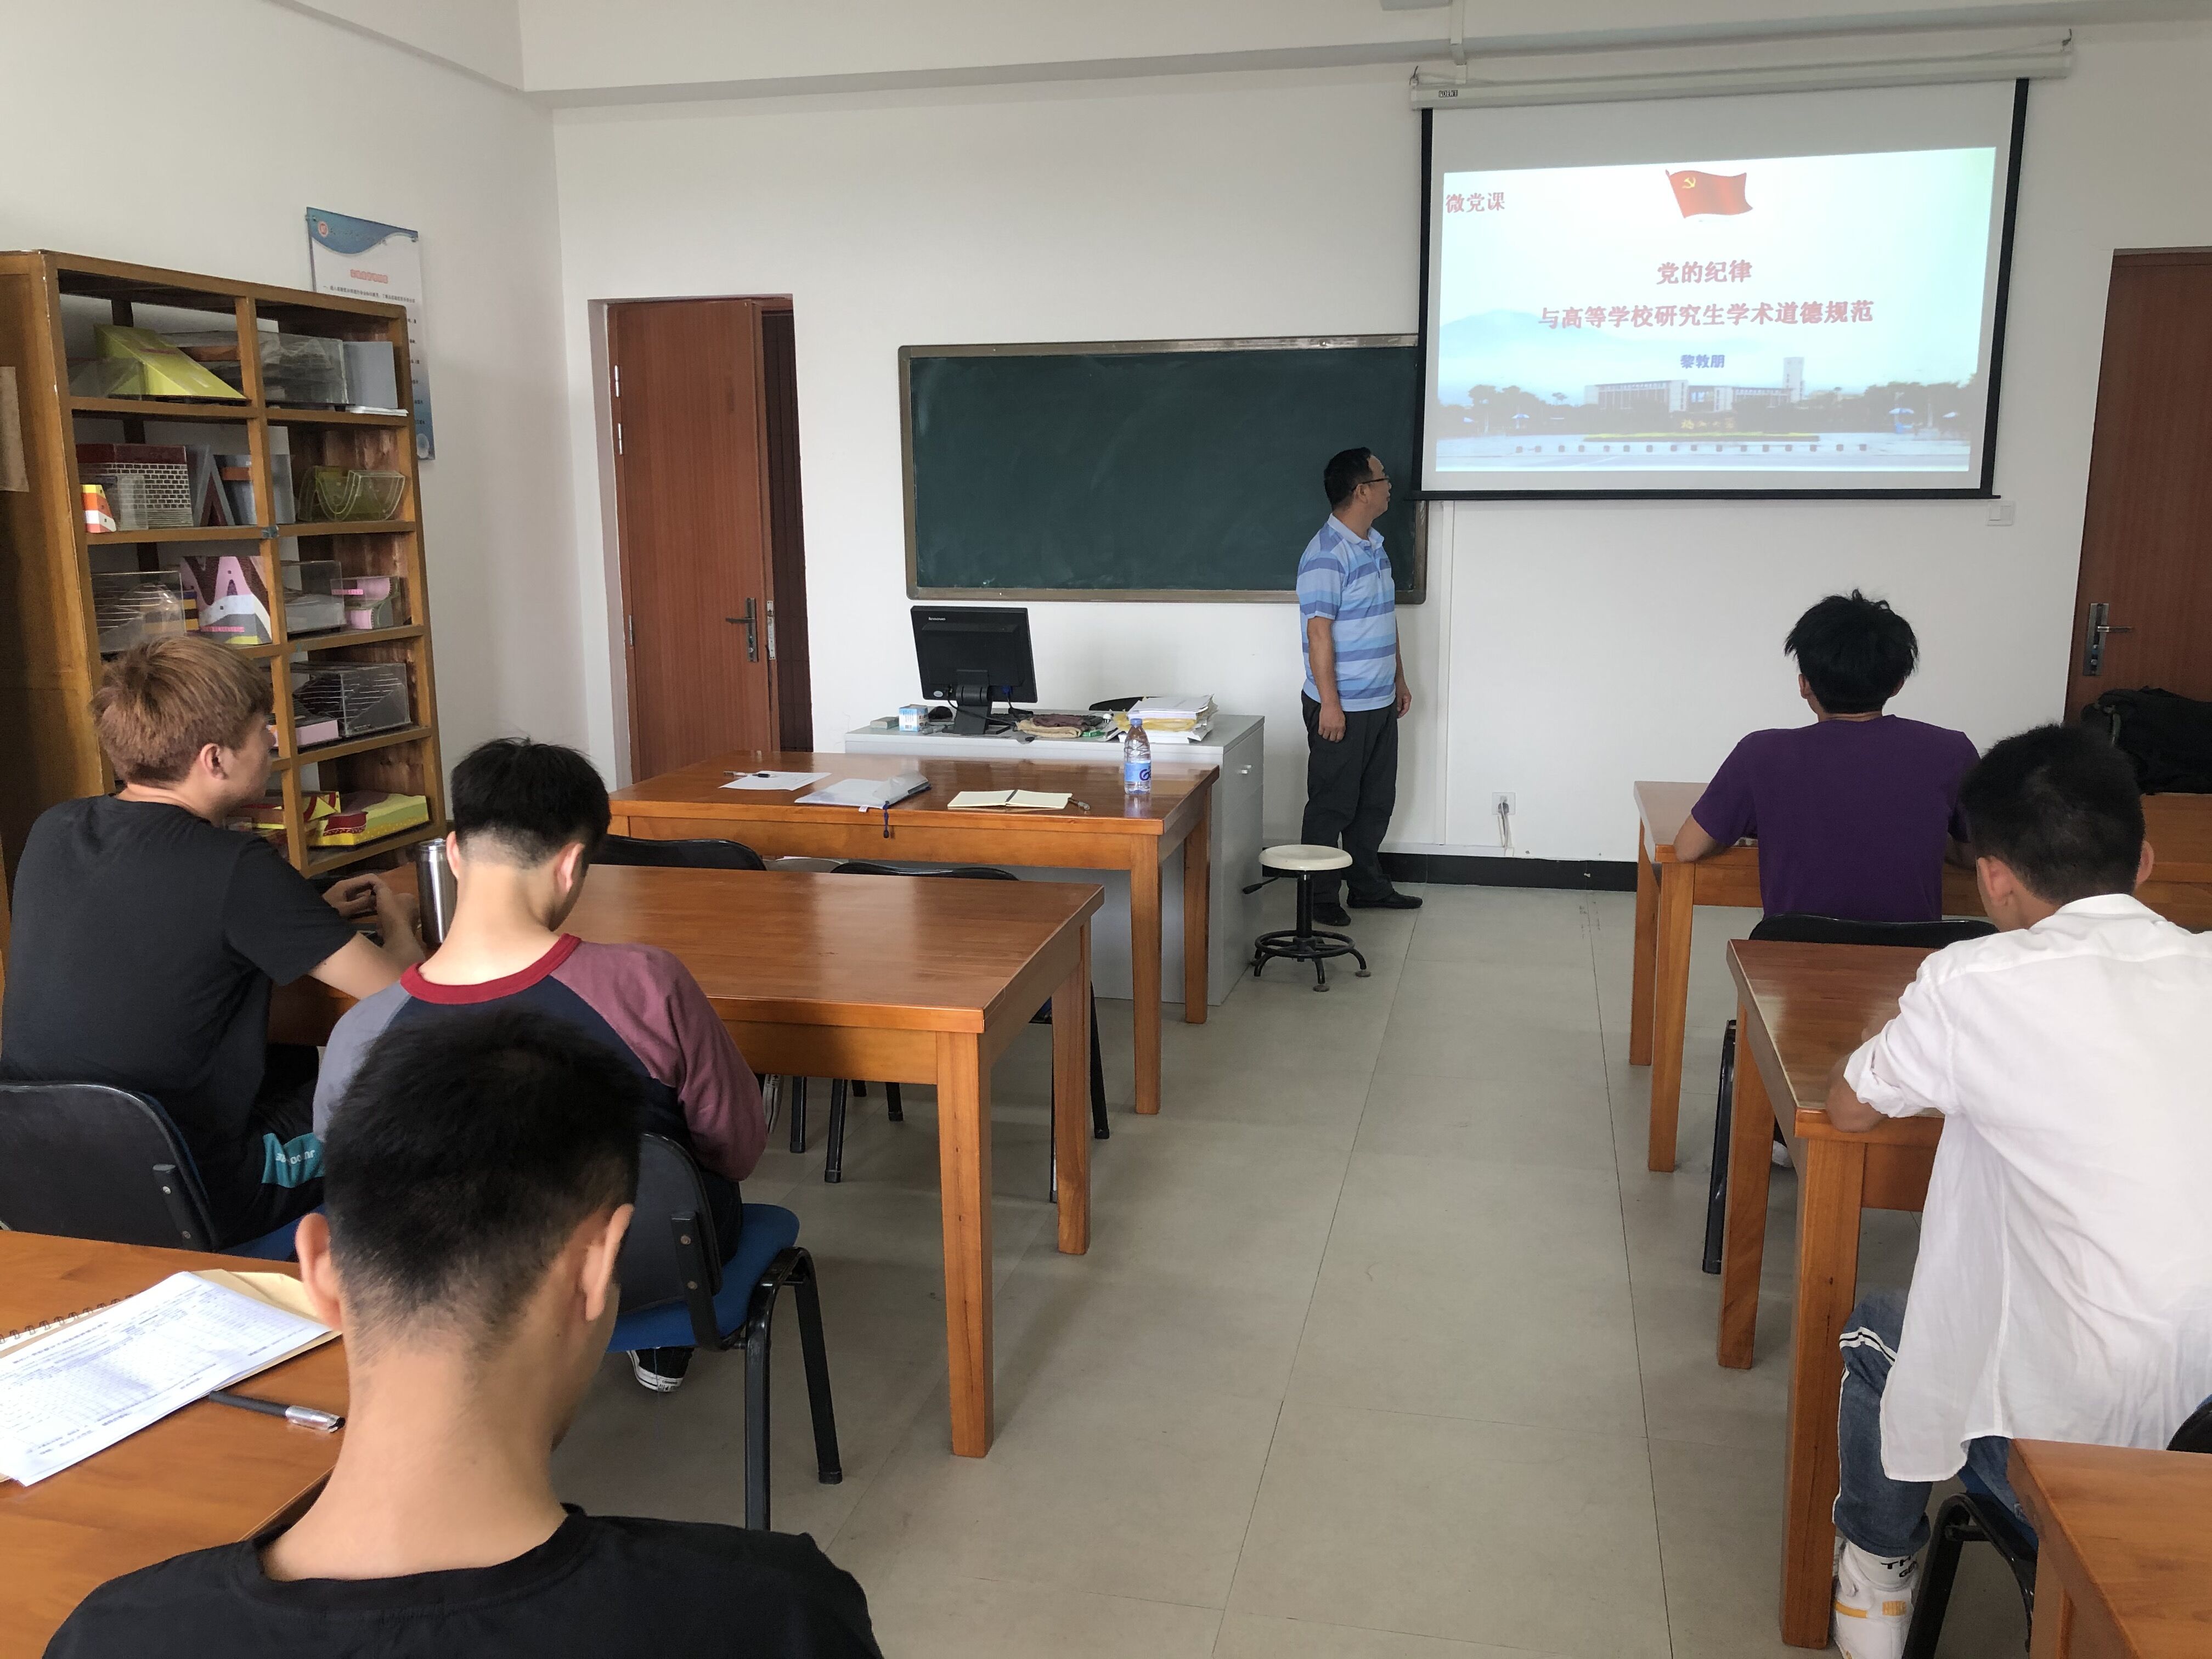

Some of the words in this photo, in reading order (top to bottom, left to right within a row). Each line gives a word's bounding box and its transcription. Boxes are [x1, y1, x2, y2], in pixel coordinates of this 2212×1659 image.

[1446, 192, 1505, 213] 微党课
[1656, 259, 1752, 285] 党的纪律
[1538, 300, 1874, 329] 与高等学校研究生学术道德规范
